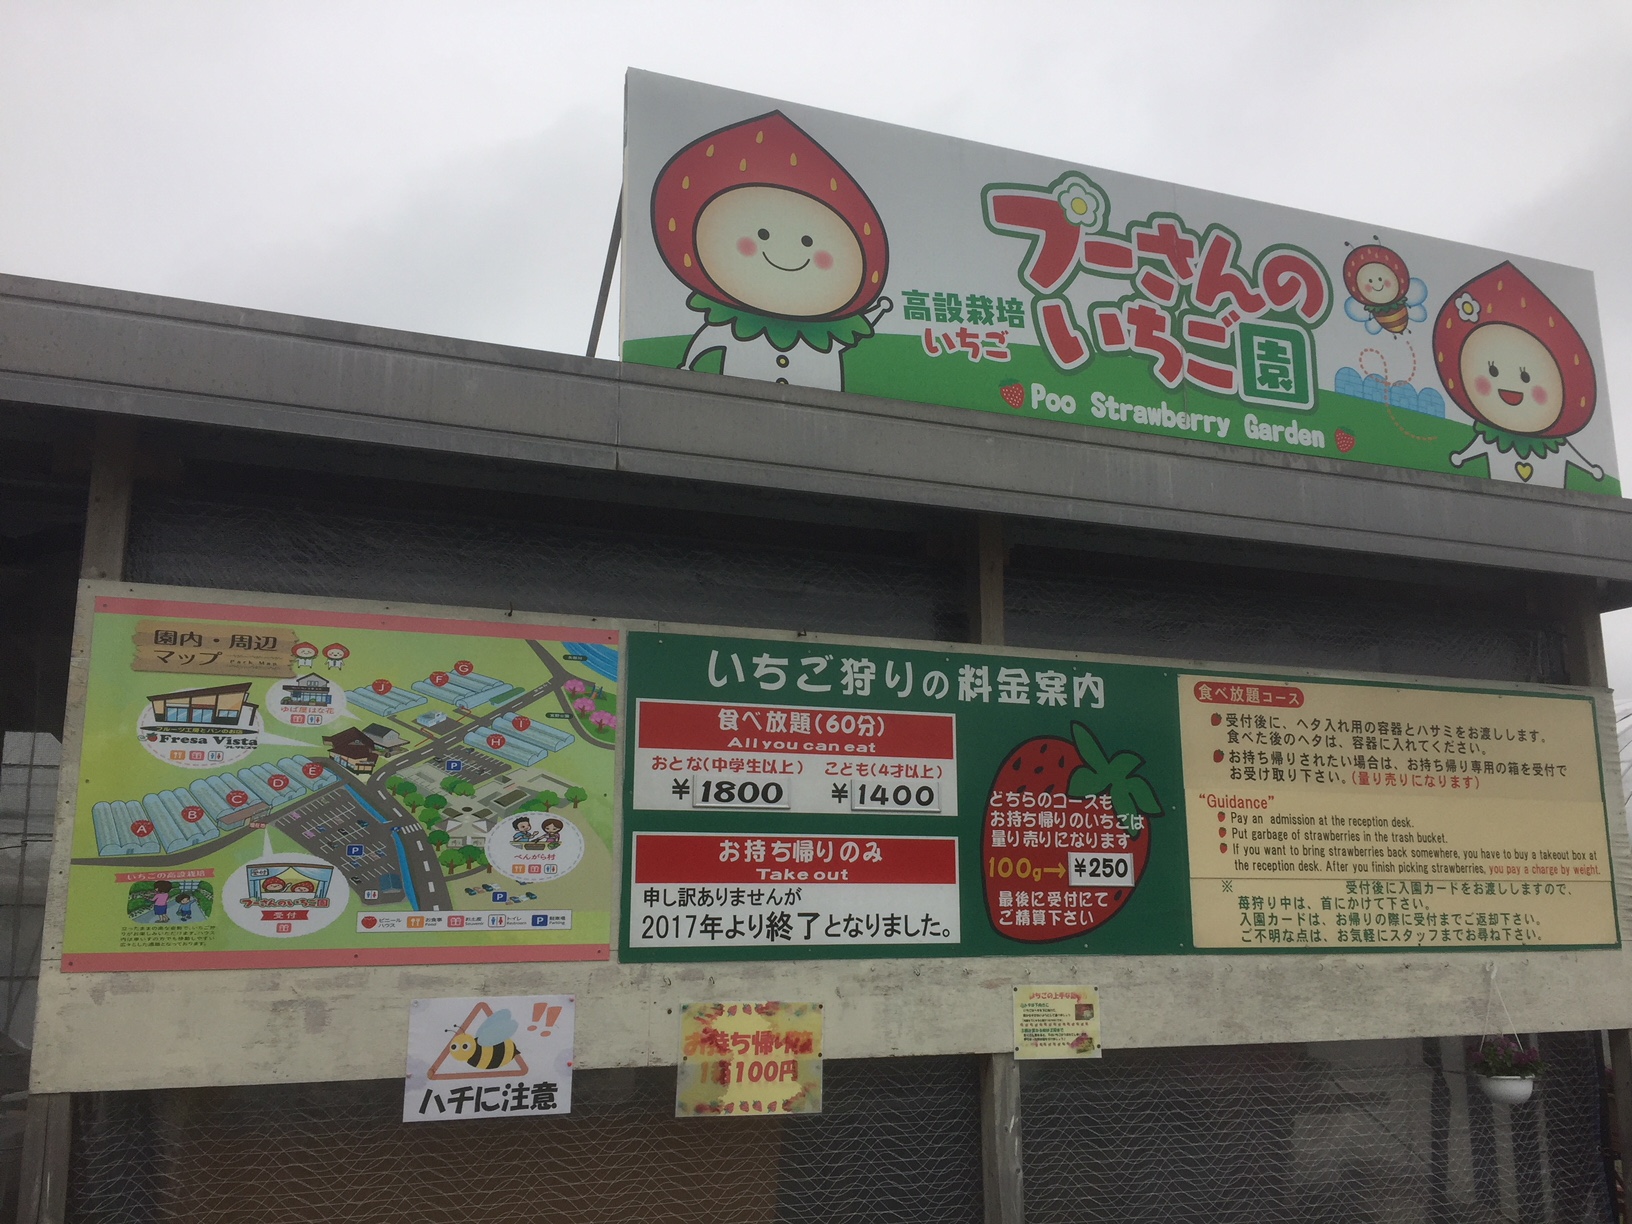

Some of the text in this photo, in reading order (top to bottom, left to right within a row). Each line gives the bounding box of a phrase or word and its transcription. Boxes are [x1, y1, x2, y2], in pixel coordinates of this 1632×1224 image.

[901, 289, 1025, 328] 高設栽培
[924, 326, 1009, 360] いちご
[1036, 300, 1314, 409] いちご園
[1030, 382, 1326, 448] Poo Strawberry Garden
[153, 650, 223, 666] マップ
[458, 664, 469, 673] G
[435, 675, 443, 684] F
[706, 649, 1106, 709] いちご狩りの料金案内
[1198, 683, 1300, 706] 食べ放題コース
[717, 708, 885, 738] 食べ放題(60分)
[159, 734, 259, 746] Fresa Vista
[491, 738, 501, 746] H
[727, 737, 876, 754] All you can eat
[308, 767, 316, 776] E
[651, 755, 944, 780] おとな(中学生以上) こども(4才以上)
[273, 778, 284, 787] D
[231, 795, 243, 804] C
[989, 790, 1113, 810] どちらのコースも
[187, 811, 197, 820] B
[990, 810, 1145, 830] お持ち帰りのいちごは
[1230, 812, 1415, 828] Pay an admission at the reception desk.
[136, 825, 147, 834] A
[1231, 827, 1248, 840] Put
[1251, 829, 1288, 841] garbage
[1291, 829, 1301, 840] of
[1304, 829, 1361, 842] strawberries
[1374, 830, 1389, 842] the
[1391, 832, 1415, 843] trash
[1417, 832, 1448, 844] bucket.
[991, 829, 1131, 850] 量り売りになります
[718, 839, 883, 863] お持ち帰りのみ
[1243, 846, 1260, 856] you
[1263, 845, 1287, 856] want
[1289, 845, 1300, 856] to
[1302, 844, 1325, 858] bring
[1328, 845, 1385, 857] strawberries
[1387, 846, 1408, 858] back
[1410, 848, 1460, 860] somewhere,
[1463, 852, 1478, 861] you
[1480, 849, 1501, 860] have
[1514, 849, 1529, 861] buy
[1539, 850, 1570, 861] takeout
[1572, 850, 1586, 861] box
[1588, 851, 1598, 861] at
[755, 868, 849, 881] Take out
[988, 856, 1129, 882] 100g ¥250
[1234, 859, 1249, 871] the
[1252, 860, 1295, 873] reception
[1298, 861, 1322, 872] desk.
[1325, 861, 1349, 872] After
[1352, 863, 1369, 874] you
[1371, 861, 1396, 873] finish
[1398, 862, 1429, 875] picking
[1431, 863, 1486, 875] strawberries,
[1488, 866, 1504, 876] you
[1506, 866, 1521, 876] pay
[1531, 865, 1559, 876] charge
[1560, 865, 1571, 876] by
[1573, 865, 1601, 876] weight.
[1345, 880, 1572, 896] 受付後に入園カードをお渡ししますので、
[643, 887, 802, 908] 申し訳ありませんが
[998, 890, 1109, 908] 最後に受付にて
[1238, 896, 1430, 911] 苺狩り中は、首にかけて下さい。
[273, 912, 297, 920] 受付
[998, 909, 1094, 926] ご精算下さい
[641, 911, 951, 942] 2017年より終了となりました。
[418, 1081, 559, 1115] ハチに注意
